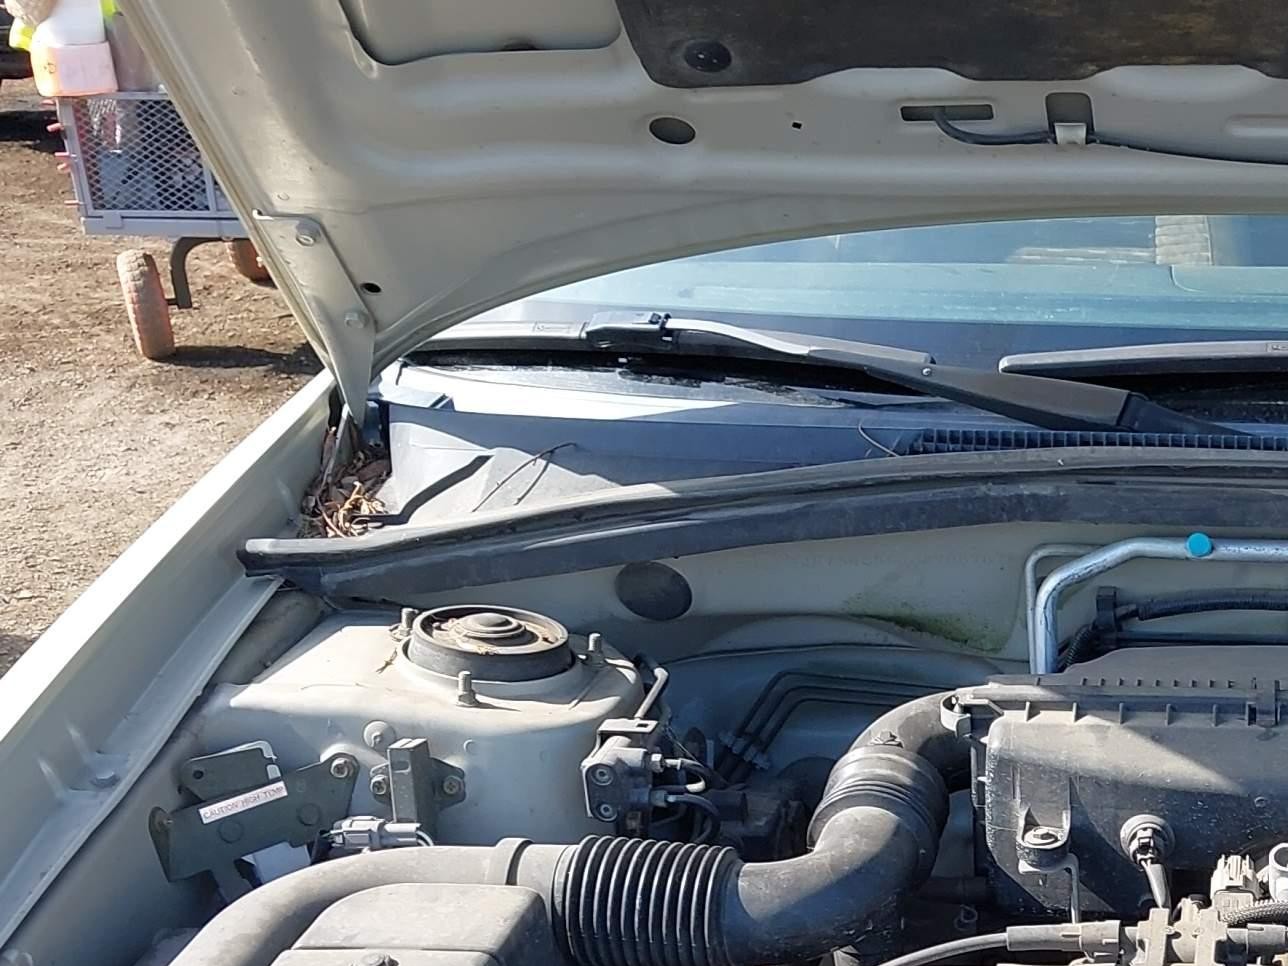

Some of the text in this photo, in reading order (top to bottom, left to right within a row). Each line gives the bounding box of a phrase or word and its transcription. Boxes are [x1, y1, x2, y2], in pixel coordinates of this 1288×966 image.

[202, 784, 285, 820] CAUTION HIGH TEMP
